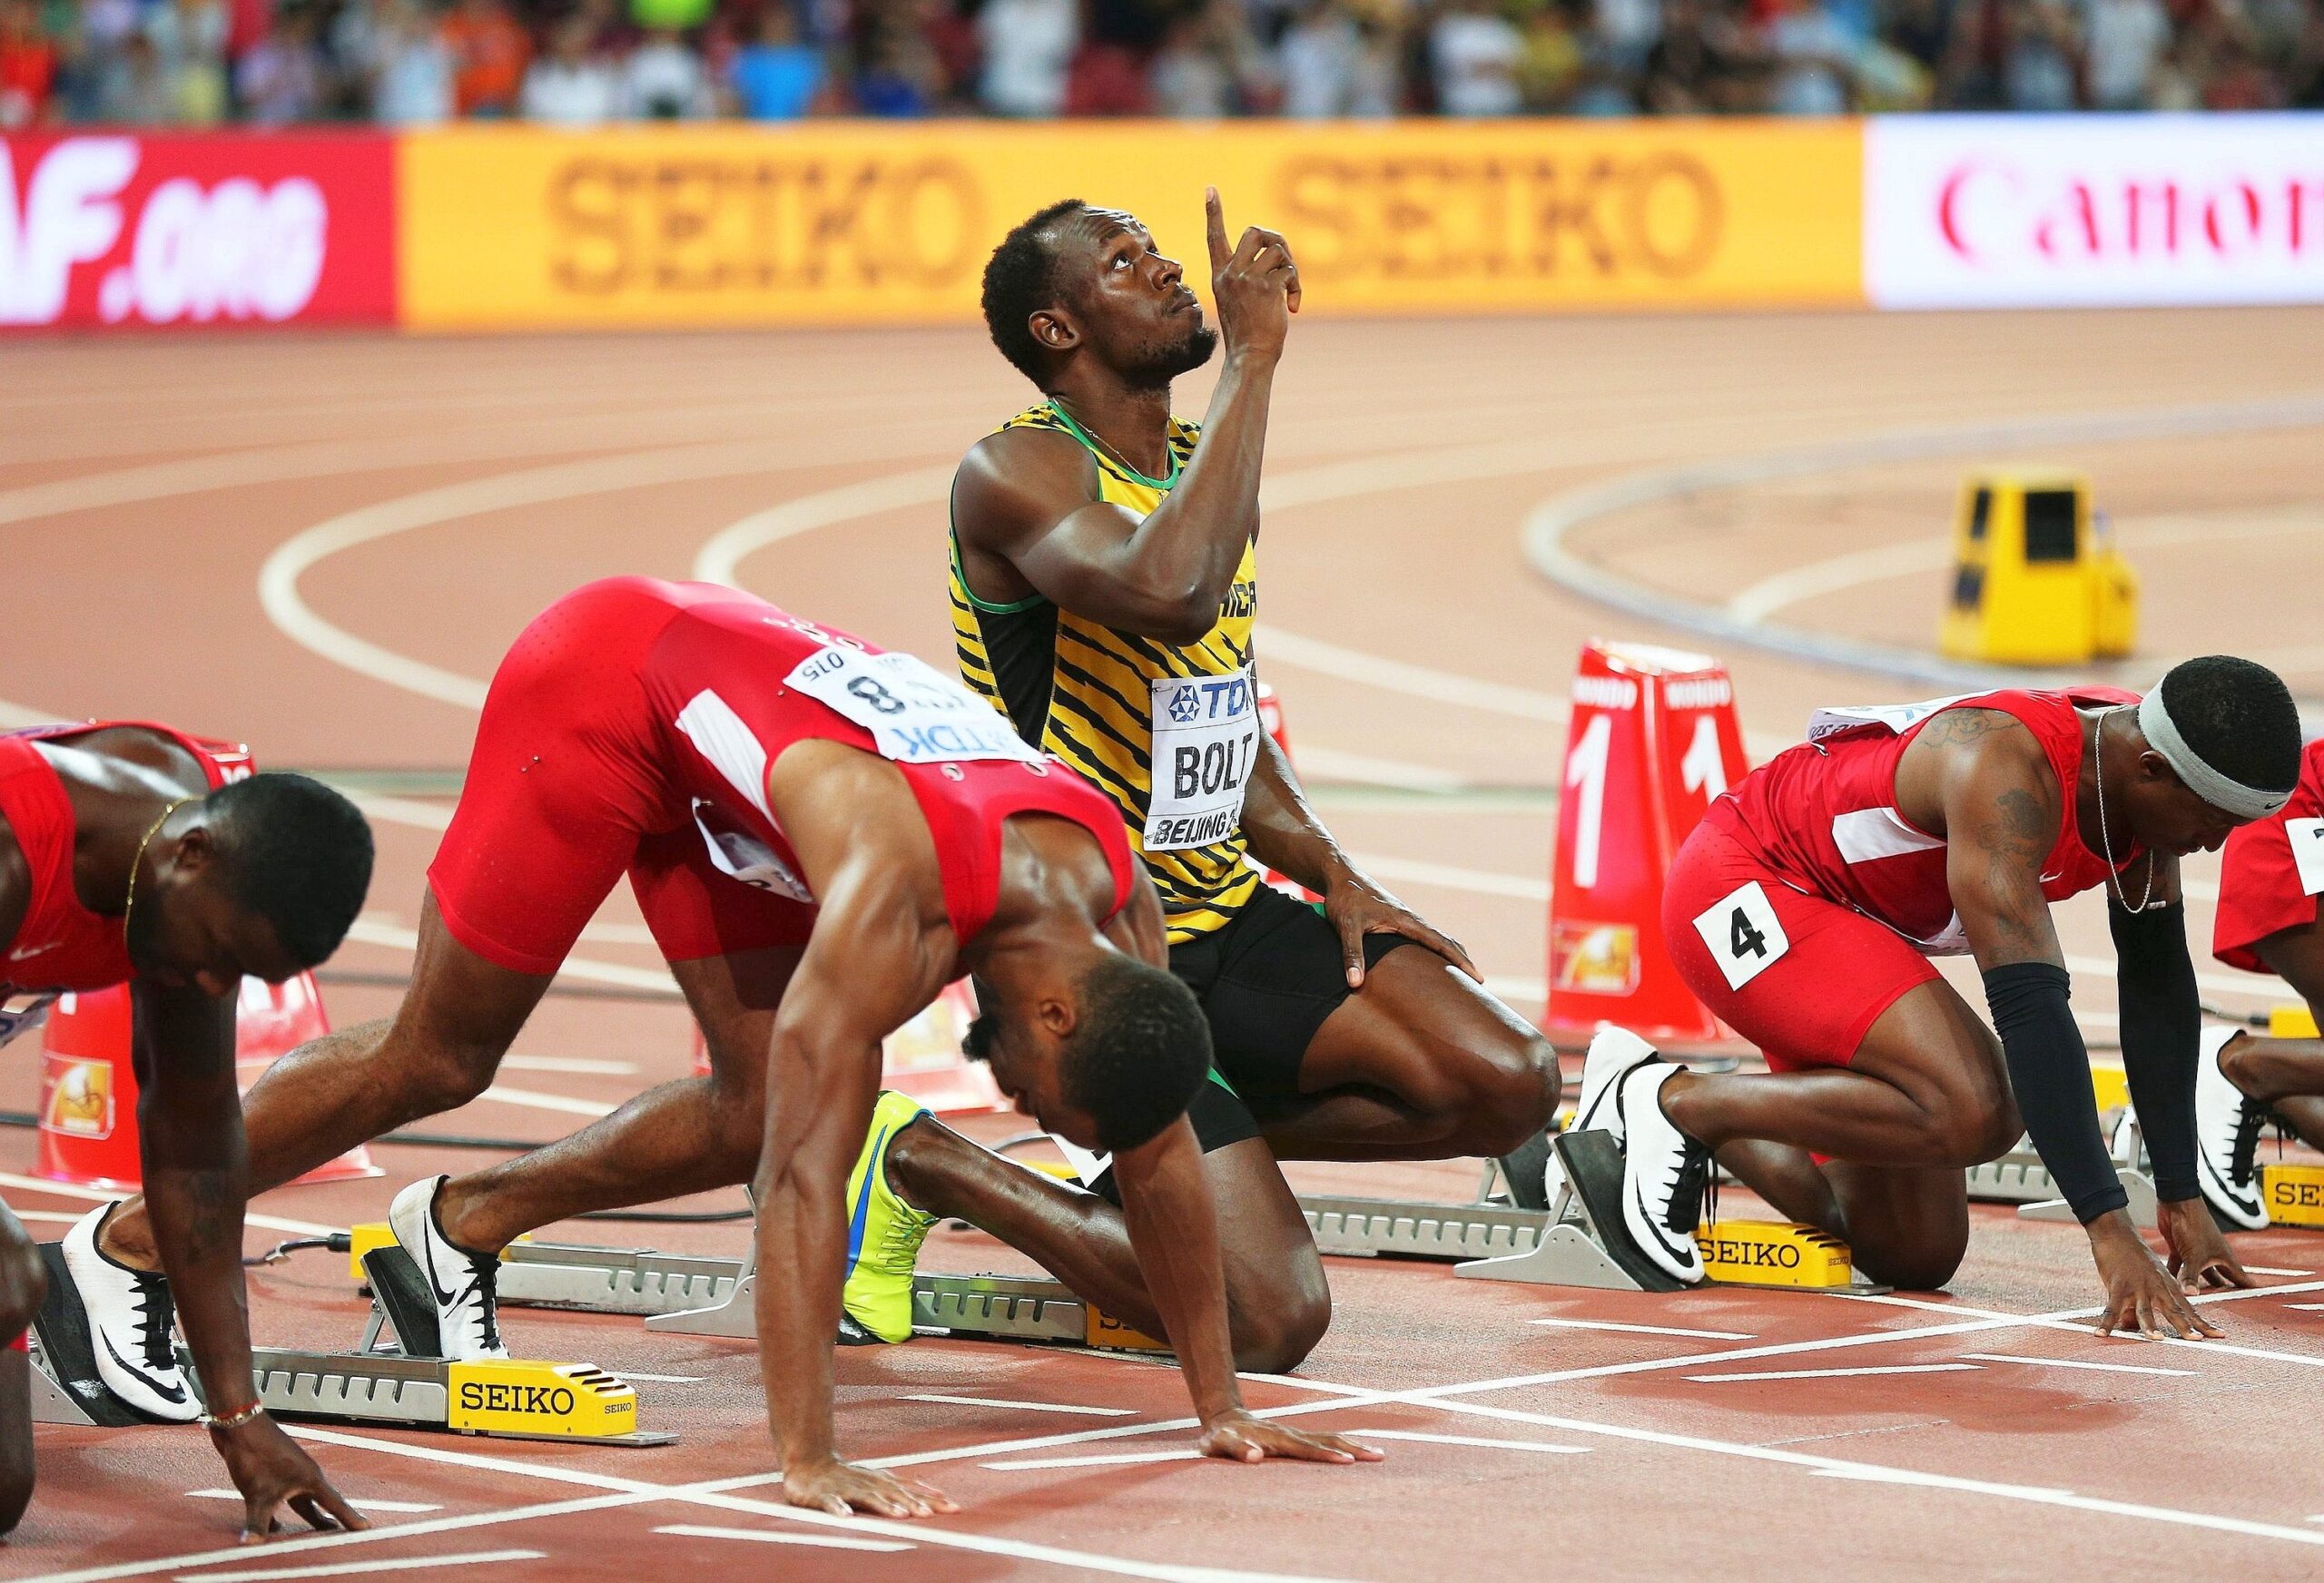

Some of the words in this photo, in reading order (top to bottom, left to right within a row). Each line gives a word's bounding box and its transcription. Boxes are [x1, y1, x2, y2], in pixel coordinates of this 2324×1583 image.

[547, 155, 988, 292] SEIKO
[1271, 152, 1723, 280] SEIKO
[1935, 152, 2324, 263] Canon
[803, 652, 844, 682] 015
[846, 675, 906, 715] 8
[890, 725, 1001, 756] TDK
[1681, 713, 1728, 806] 1
[1174, 732, 1253, 800] BOLT
[1566, 713, 1611, 889] 1
[1153, 810, 1226, 845] BEIJING
[1730, 906, 1767, 960] 4
[2275, 1183, 2324, 1205] SE
[1697, 1238, 1800, 1268] SEIKO
[461, 1382, 575, 1415] SEIKO
[604, 1402, 632, 1414] SEIKO
